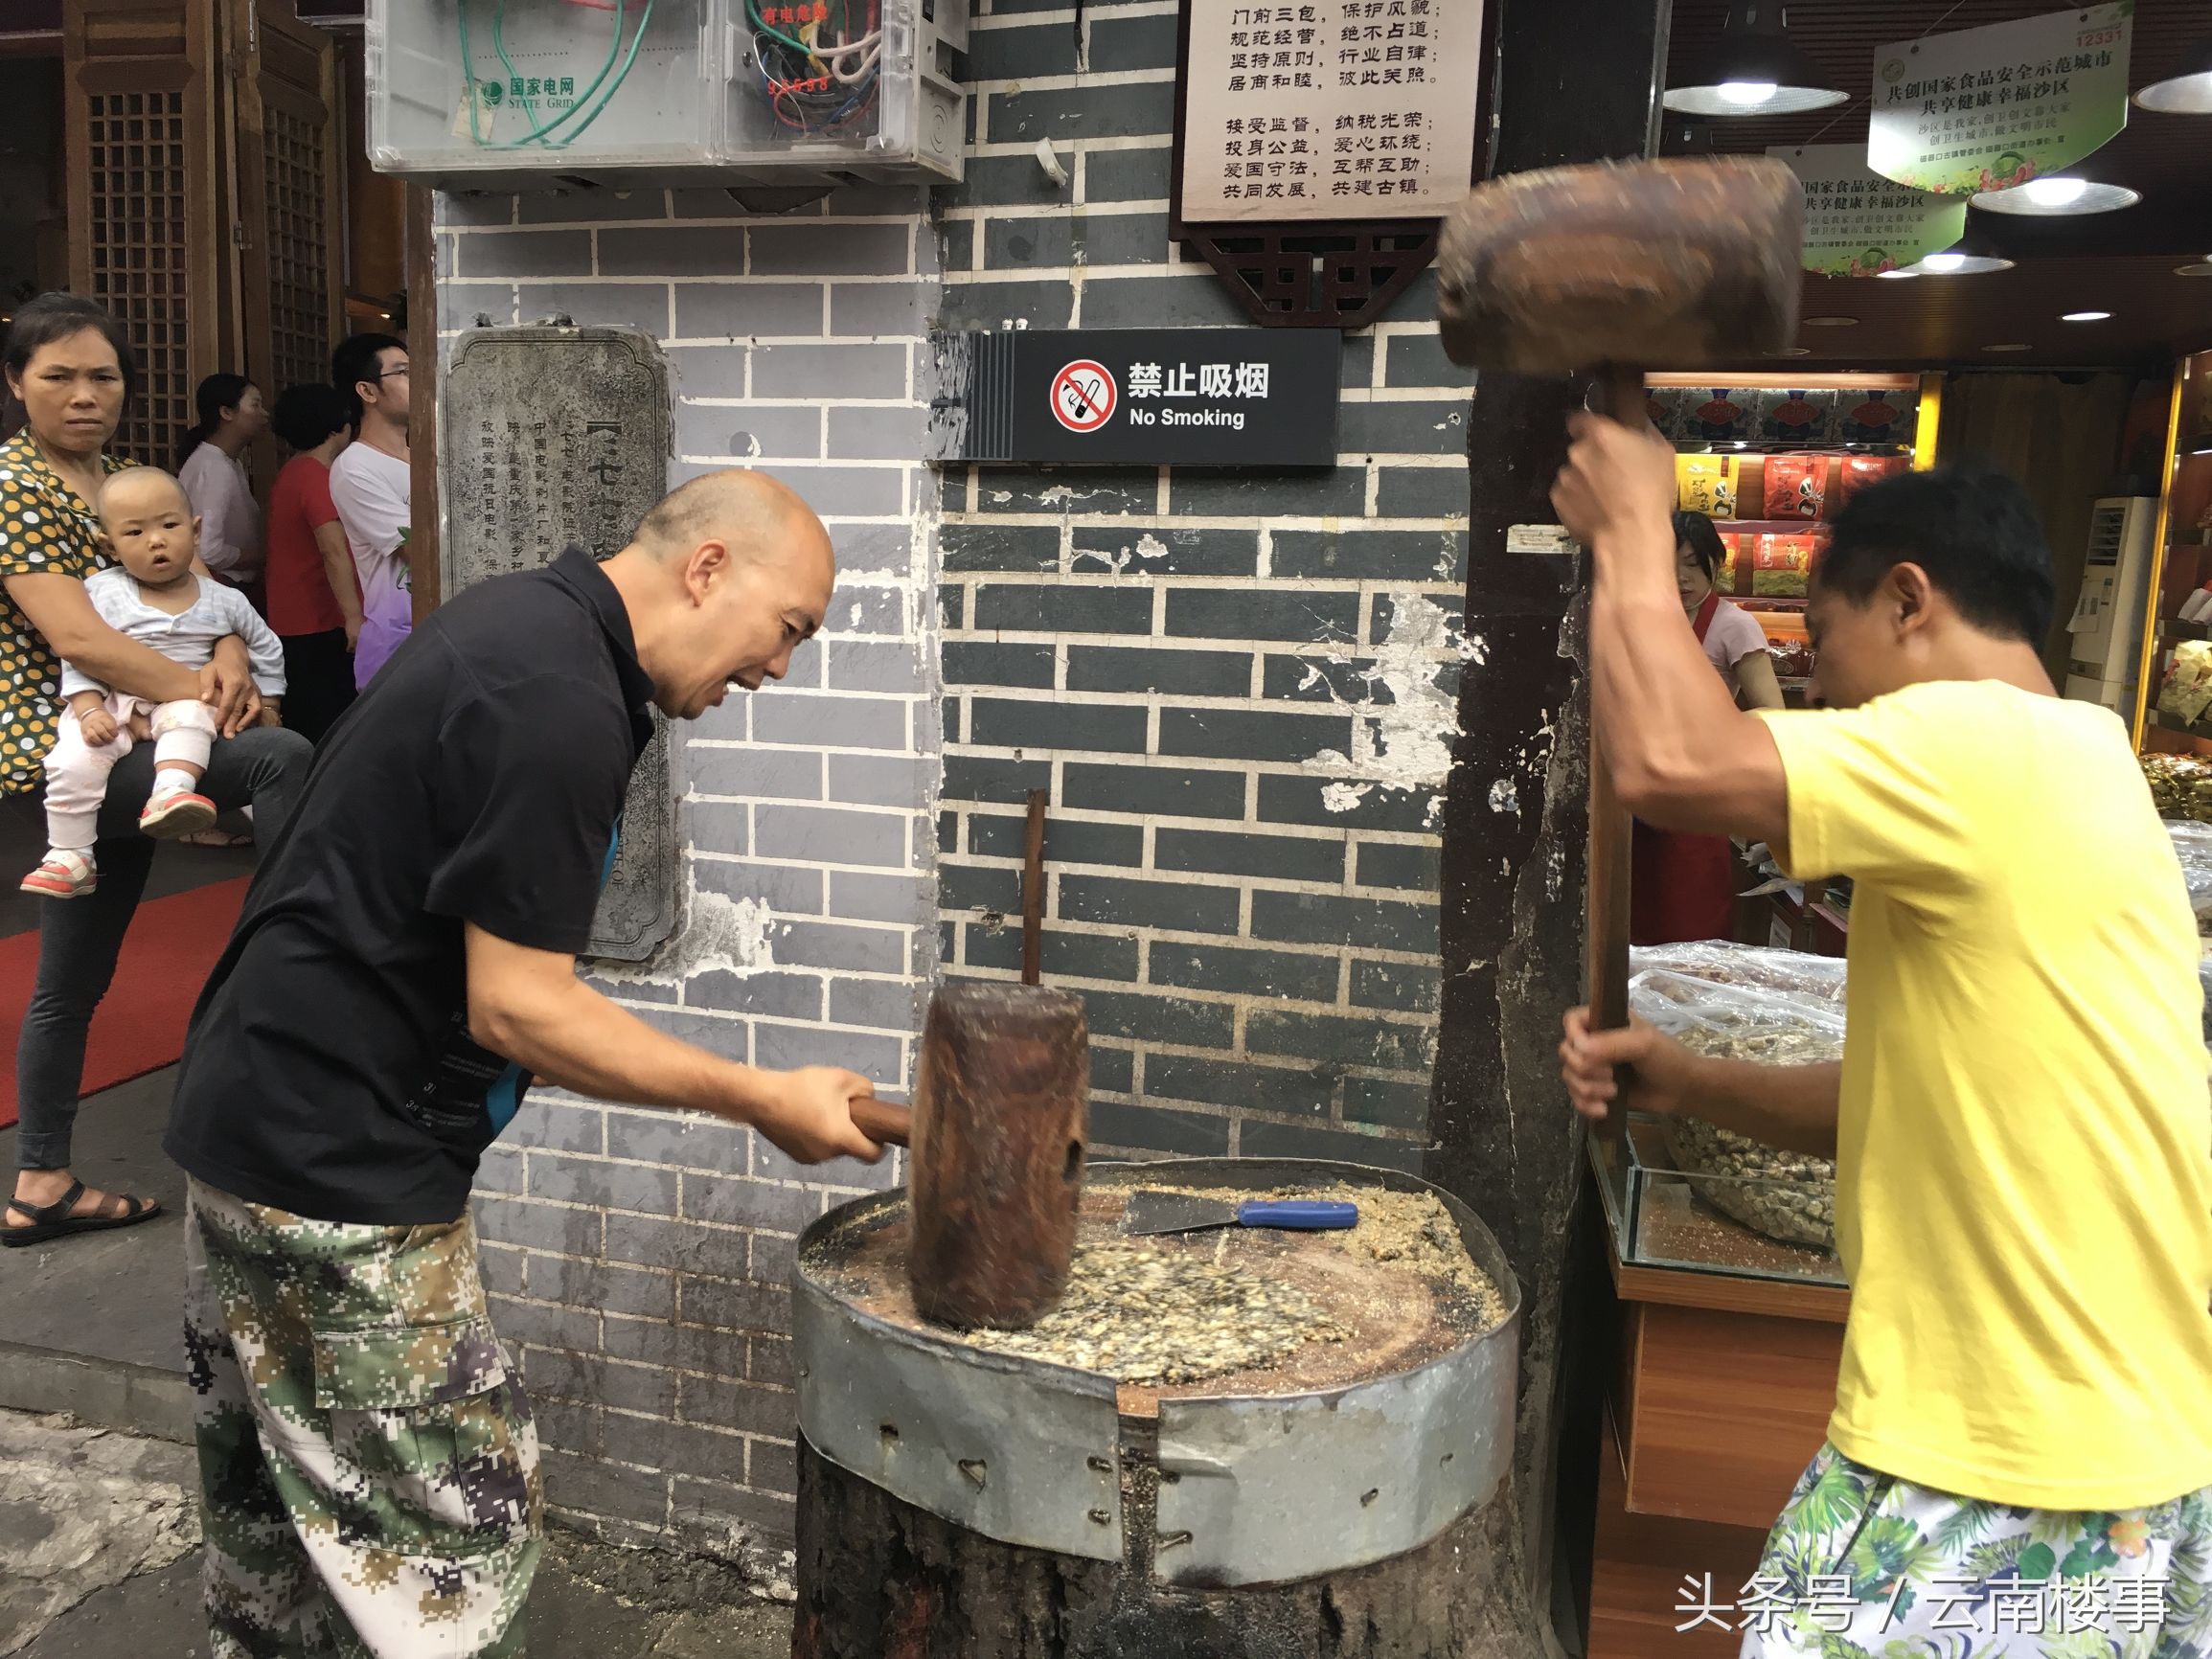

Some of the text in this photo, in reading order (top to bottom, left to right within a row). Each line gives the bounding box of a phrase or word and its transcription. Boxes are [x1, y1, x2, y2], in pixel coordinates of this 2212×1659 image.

[762, 2, 827, 25] 有电危险
[2077, 30, 2122, 48] 12331
[510, 78, 574, 96] 国家电网
[1886, 50, 2112, 104] 共创国家食品安全示范城市
[509, 98, 574, 109] STATE GRID
[1921, 78, 2069, 116] 共享健康幸福沙区
[1805, 194, 1925, 211] 共享健康幸福沙区
[1128, 361, 1269, 399] 禁止吸烟
[1129, 409, 1244, 431] No Smoking
